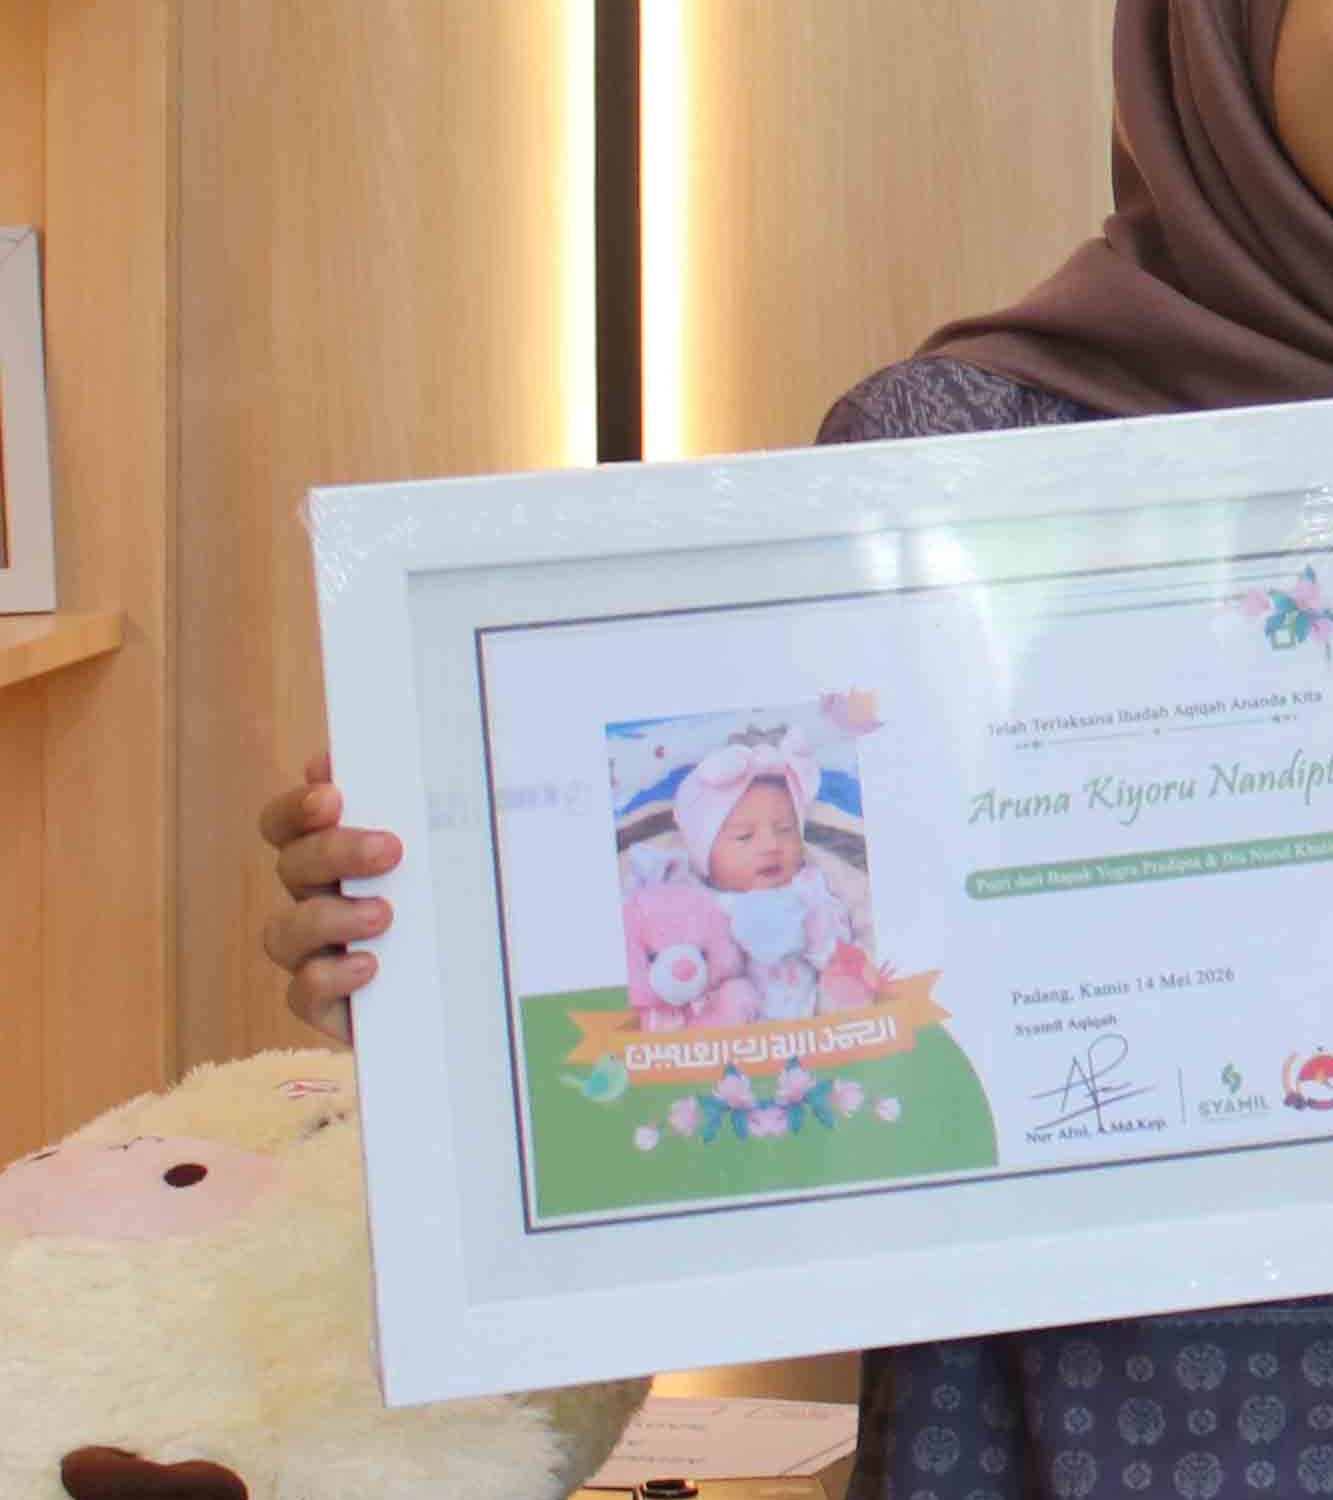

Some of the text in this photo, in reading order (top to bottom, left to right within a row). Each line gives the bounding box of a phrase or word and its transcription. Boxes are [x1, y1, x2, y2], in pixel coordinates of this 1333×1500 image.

[1031, 711, 1114, 732] Terlaksana
[1117, 705, 1169, 724] Ibadah
[1175, 700, 1226, 720] Aqiqah
[1231, 692, 1288, 711] Ananda
[1291, 688, 1323, 704] Kita
[968, 787, 1071, 825] Aruna
[1082, 775, 1196, 827] Kiyoru
[1011, 967, 1235, 1007] Padang, Kamis 14 Mei 2026
[1198, 1095, 1271, 1115] SYAMIL
